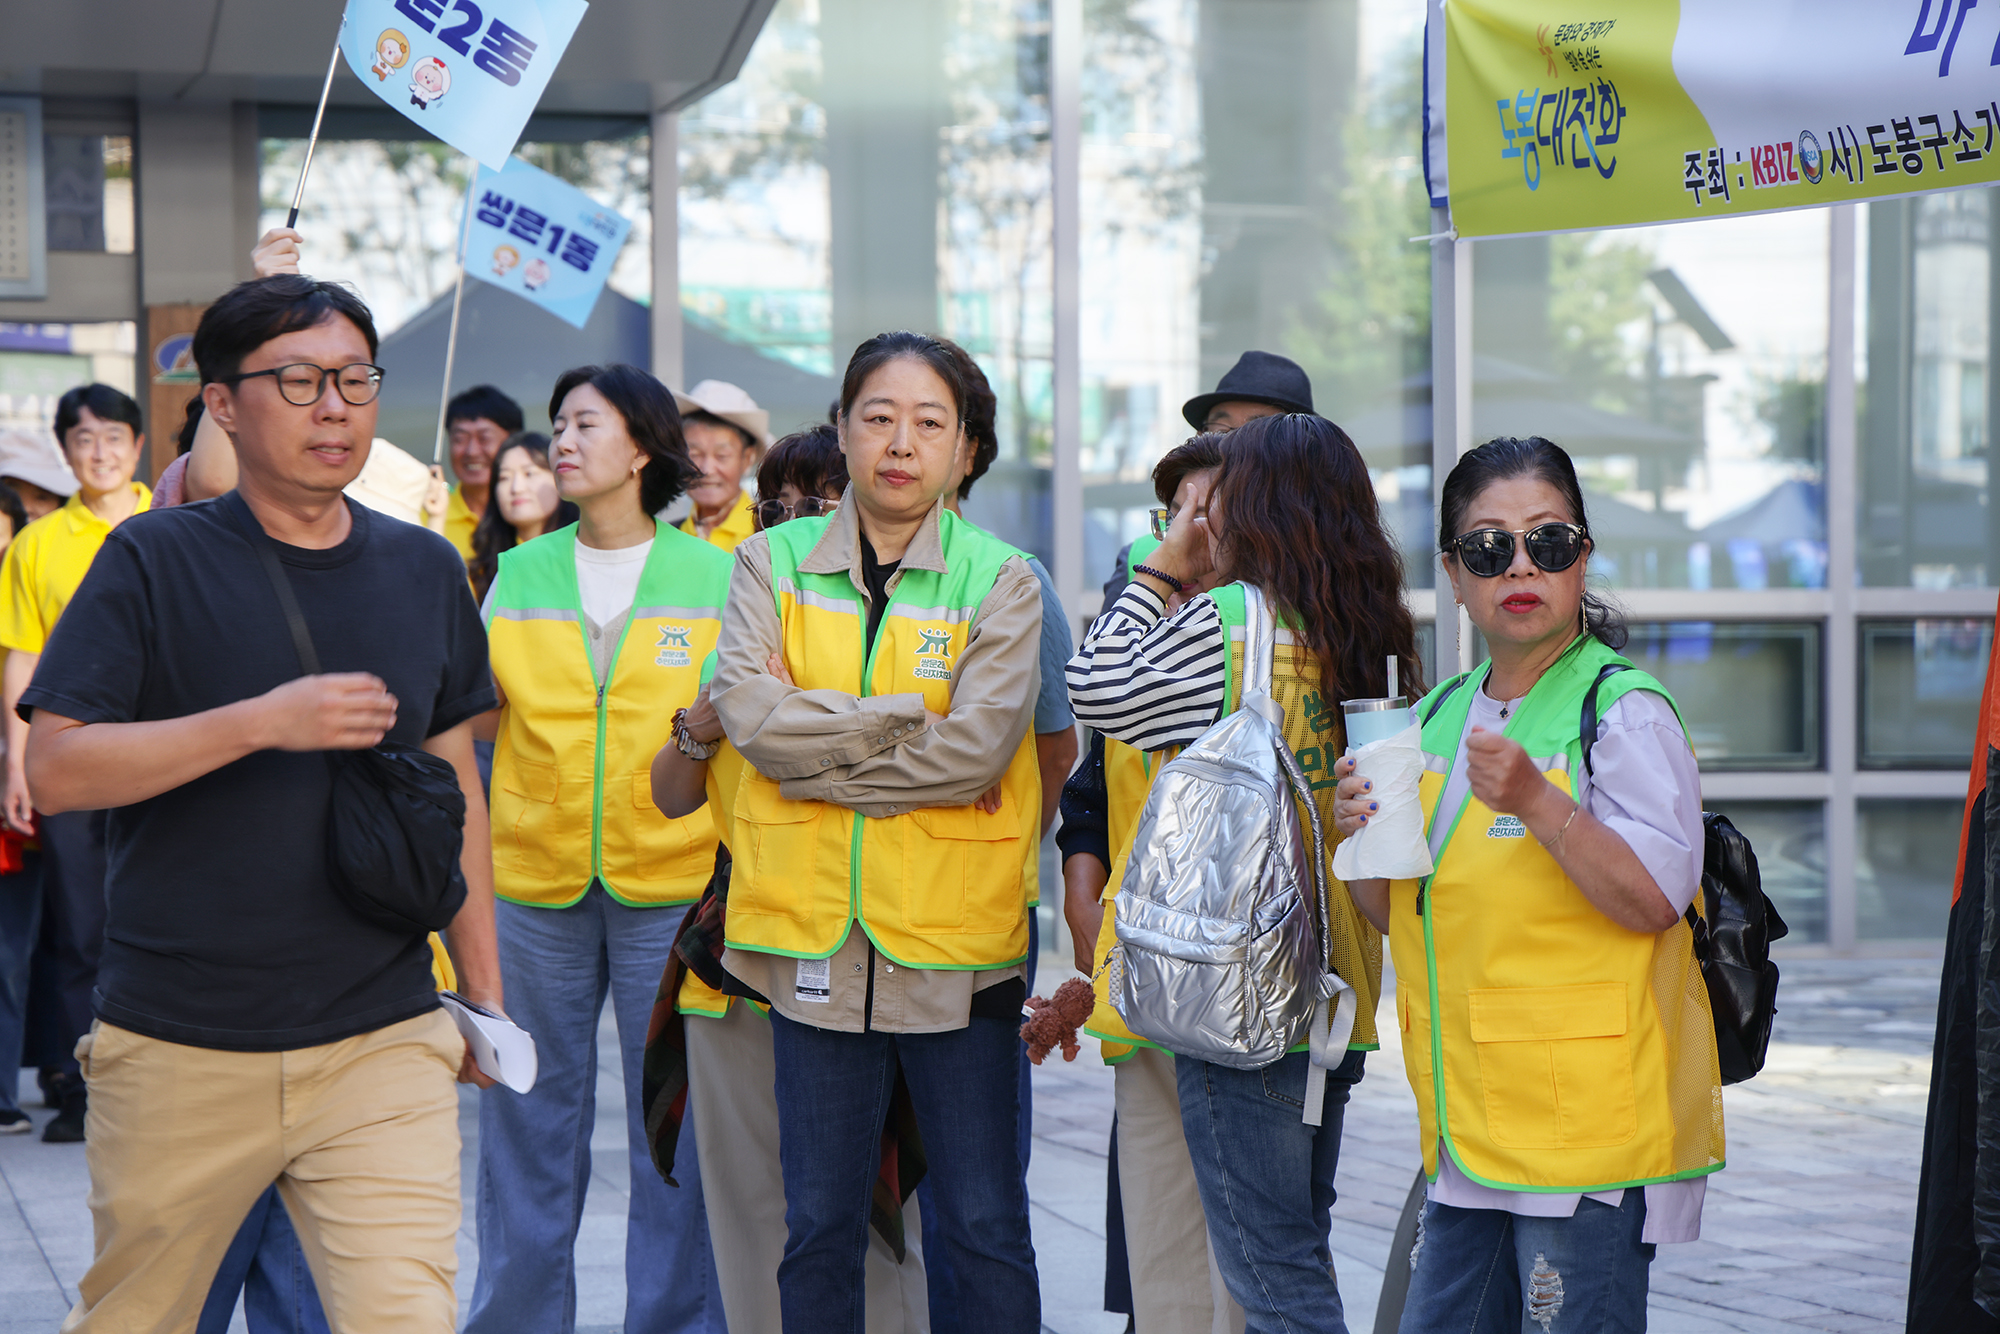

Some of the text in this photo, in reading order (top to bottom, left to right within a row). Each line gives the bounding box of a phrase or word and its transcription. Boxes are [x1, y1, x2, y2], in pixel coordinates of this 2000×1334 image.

[1554, 19, 1617, 46] 문화와 경제가
[1685, 147, 1730, 204] 주최
[1751, 141, 1799, 186] KBIZ
[477, 190, 600, 272] 쌍문1동
